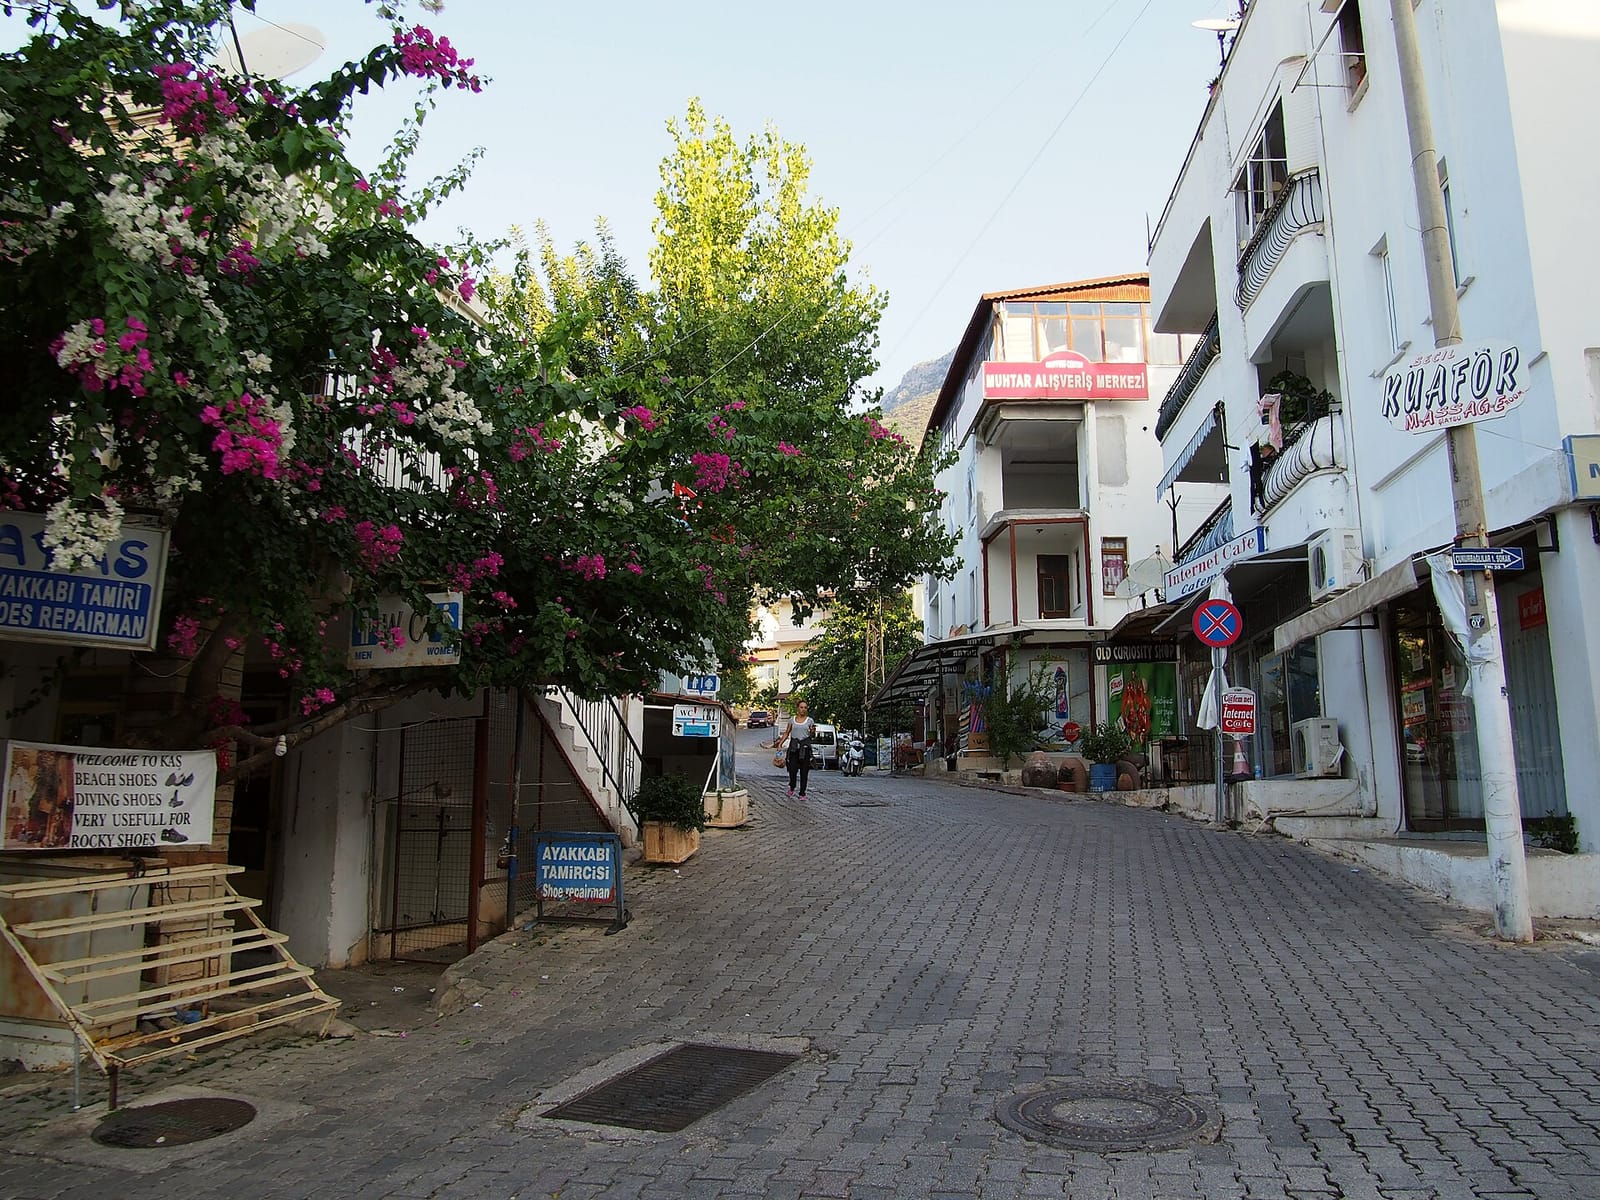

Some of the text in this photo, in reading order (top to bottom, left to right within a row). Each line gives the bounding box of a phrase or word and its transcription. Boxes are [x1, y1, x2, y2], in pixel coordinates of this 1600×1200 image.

[986, 371, 1145, 391] MUHTAR ALIŞVERİŞ MERKEZİ
[1404, 394, 1507, 430] MASSAGE
[1167, 536, 1255, 588] Internet Cafe
[82, 582, 142, 610] TAMİRİ
[38, 606, 144, 638] REPAIRMAN
[355, 651, 372, 660] MEN
[1095, 644, 1175, 661] OLD CURIOSITY SHOP
[680, 709, 693, 717] WC
[1225, 719, 1252, 728] C@fe
[75, 753, 139, 768] WELCOME
[142, 755, 157, 768] TO
[75, 772, 158, 787] BEACH SHOES
[76, 792, 162, 807] DIVING SHOES
[74, 812, 191, 828] VERY USEFULL FOR
[71, 833, 156, 848] ROCKY SHOES
[542, 846, 610, 862] AYAKKABI
[542, 883, 610, 899] Shoe repairman
